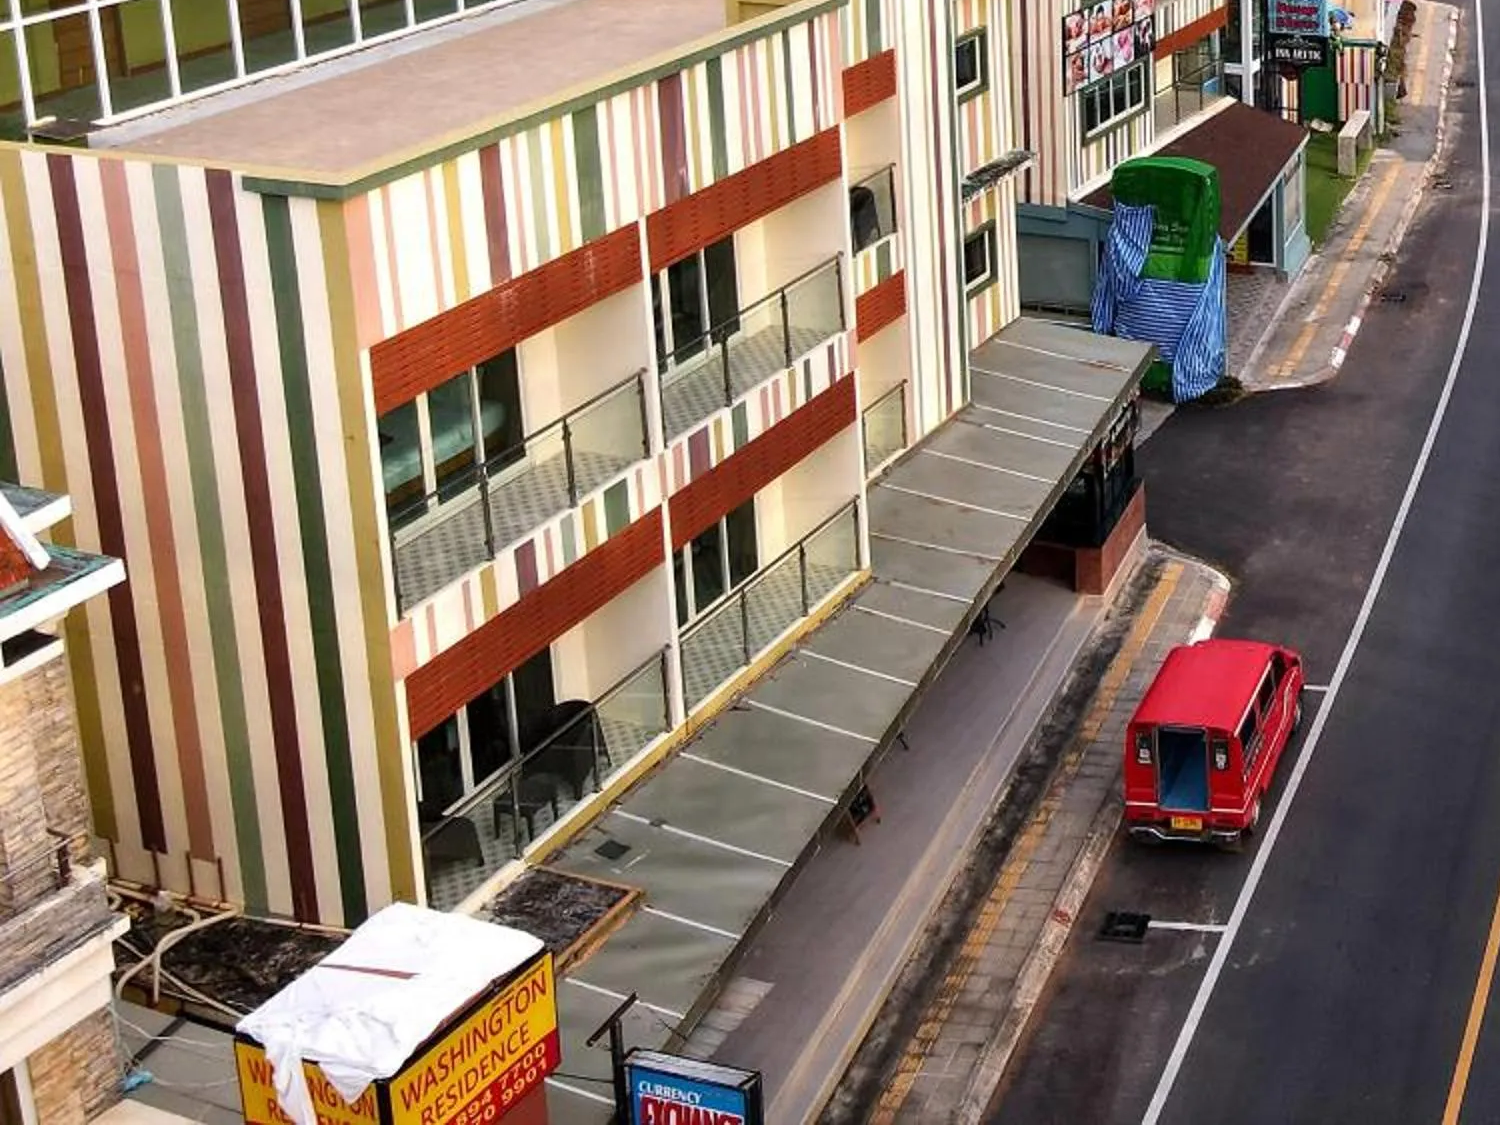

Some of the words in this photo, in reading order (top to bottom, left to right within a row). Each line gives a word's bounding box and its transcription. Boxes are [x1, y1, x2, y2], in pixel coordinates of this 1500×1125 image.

[401, 970, 547, 1111] WASHINGTON
[421, 1020, 530, 1125] RESIDENCE
[499, 1042, 546, 1090] 7700
[501, 1057, 547, 1105] 9901
[639, 1081, 702, 1105] CURRENCY
